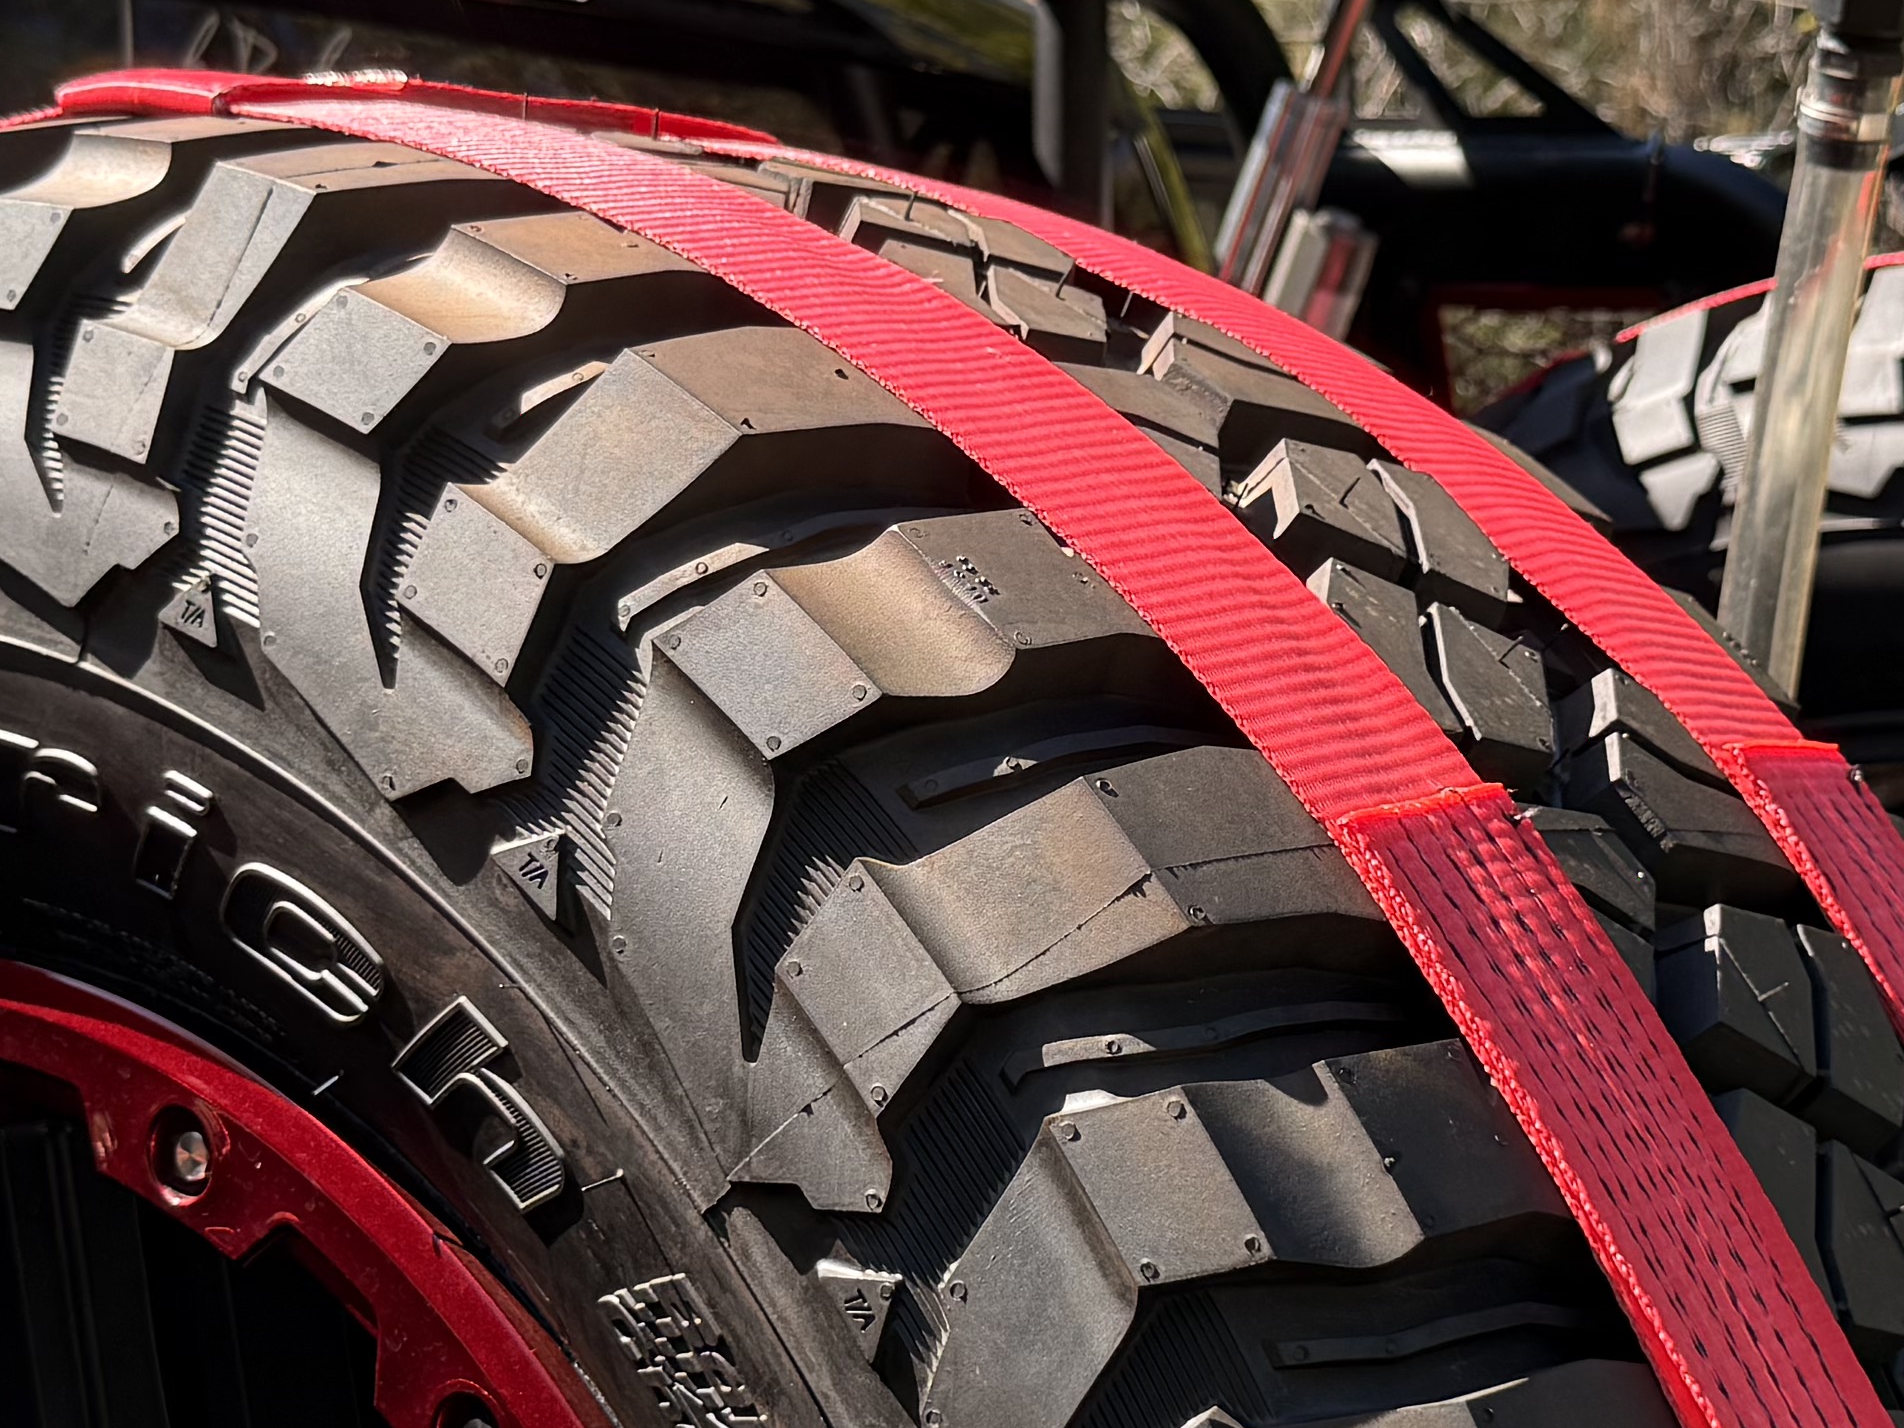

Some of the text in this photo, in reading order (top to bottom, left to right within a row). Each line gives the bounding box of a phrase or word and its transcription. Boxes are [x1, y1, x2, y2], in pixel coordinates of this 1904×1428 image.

[181, 599, 206, 628] T/A
[518, 851, 549, 890] T/A
[843, 1287, 876, 1333] T/A
